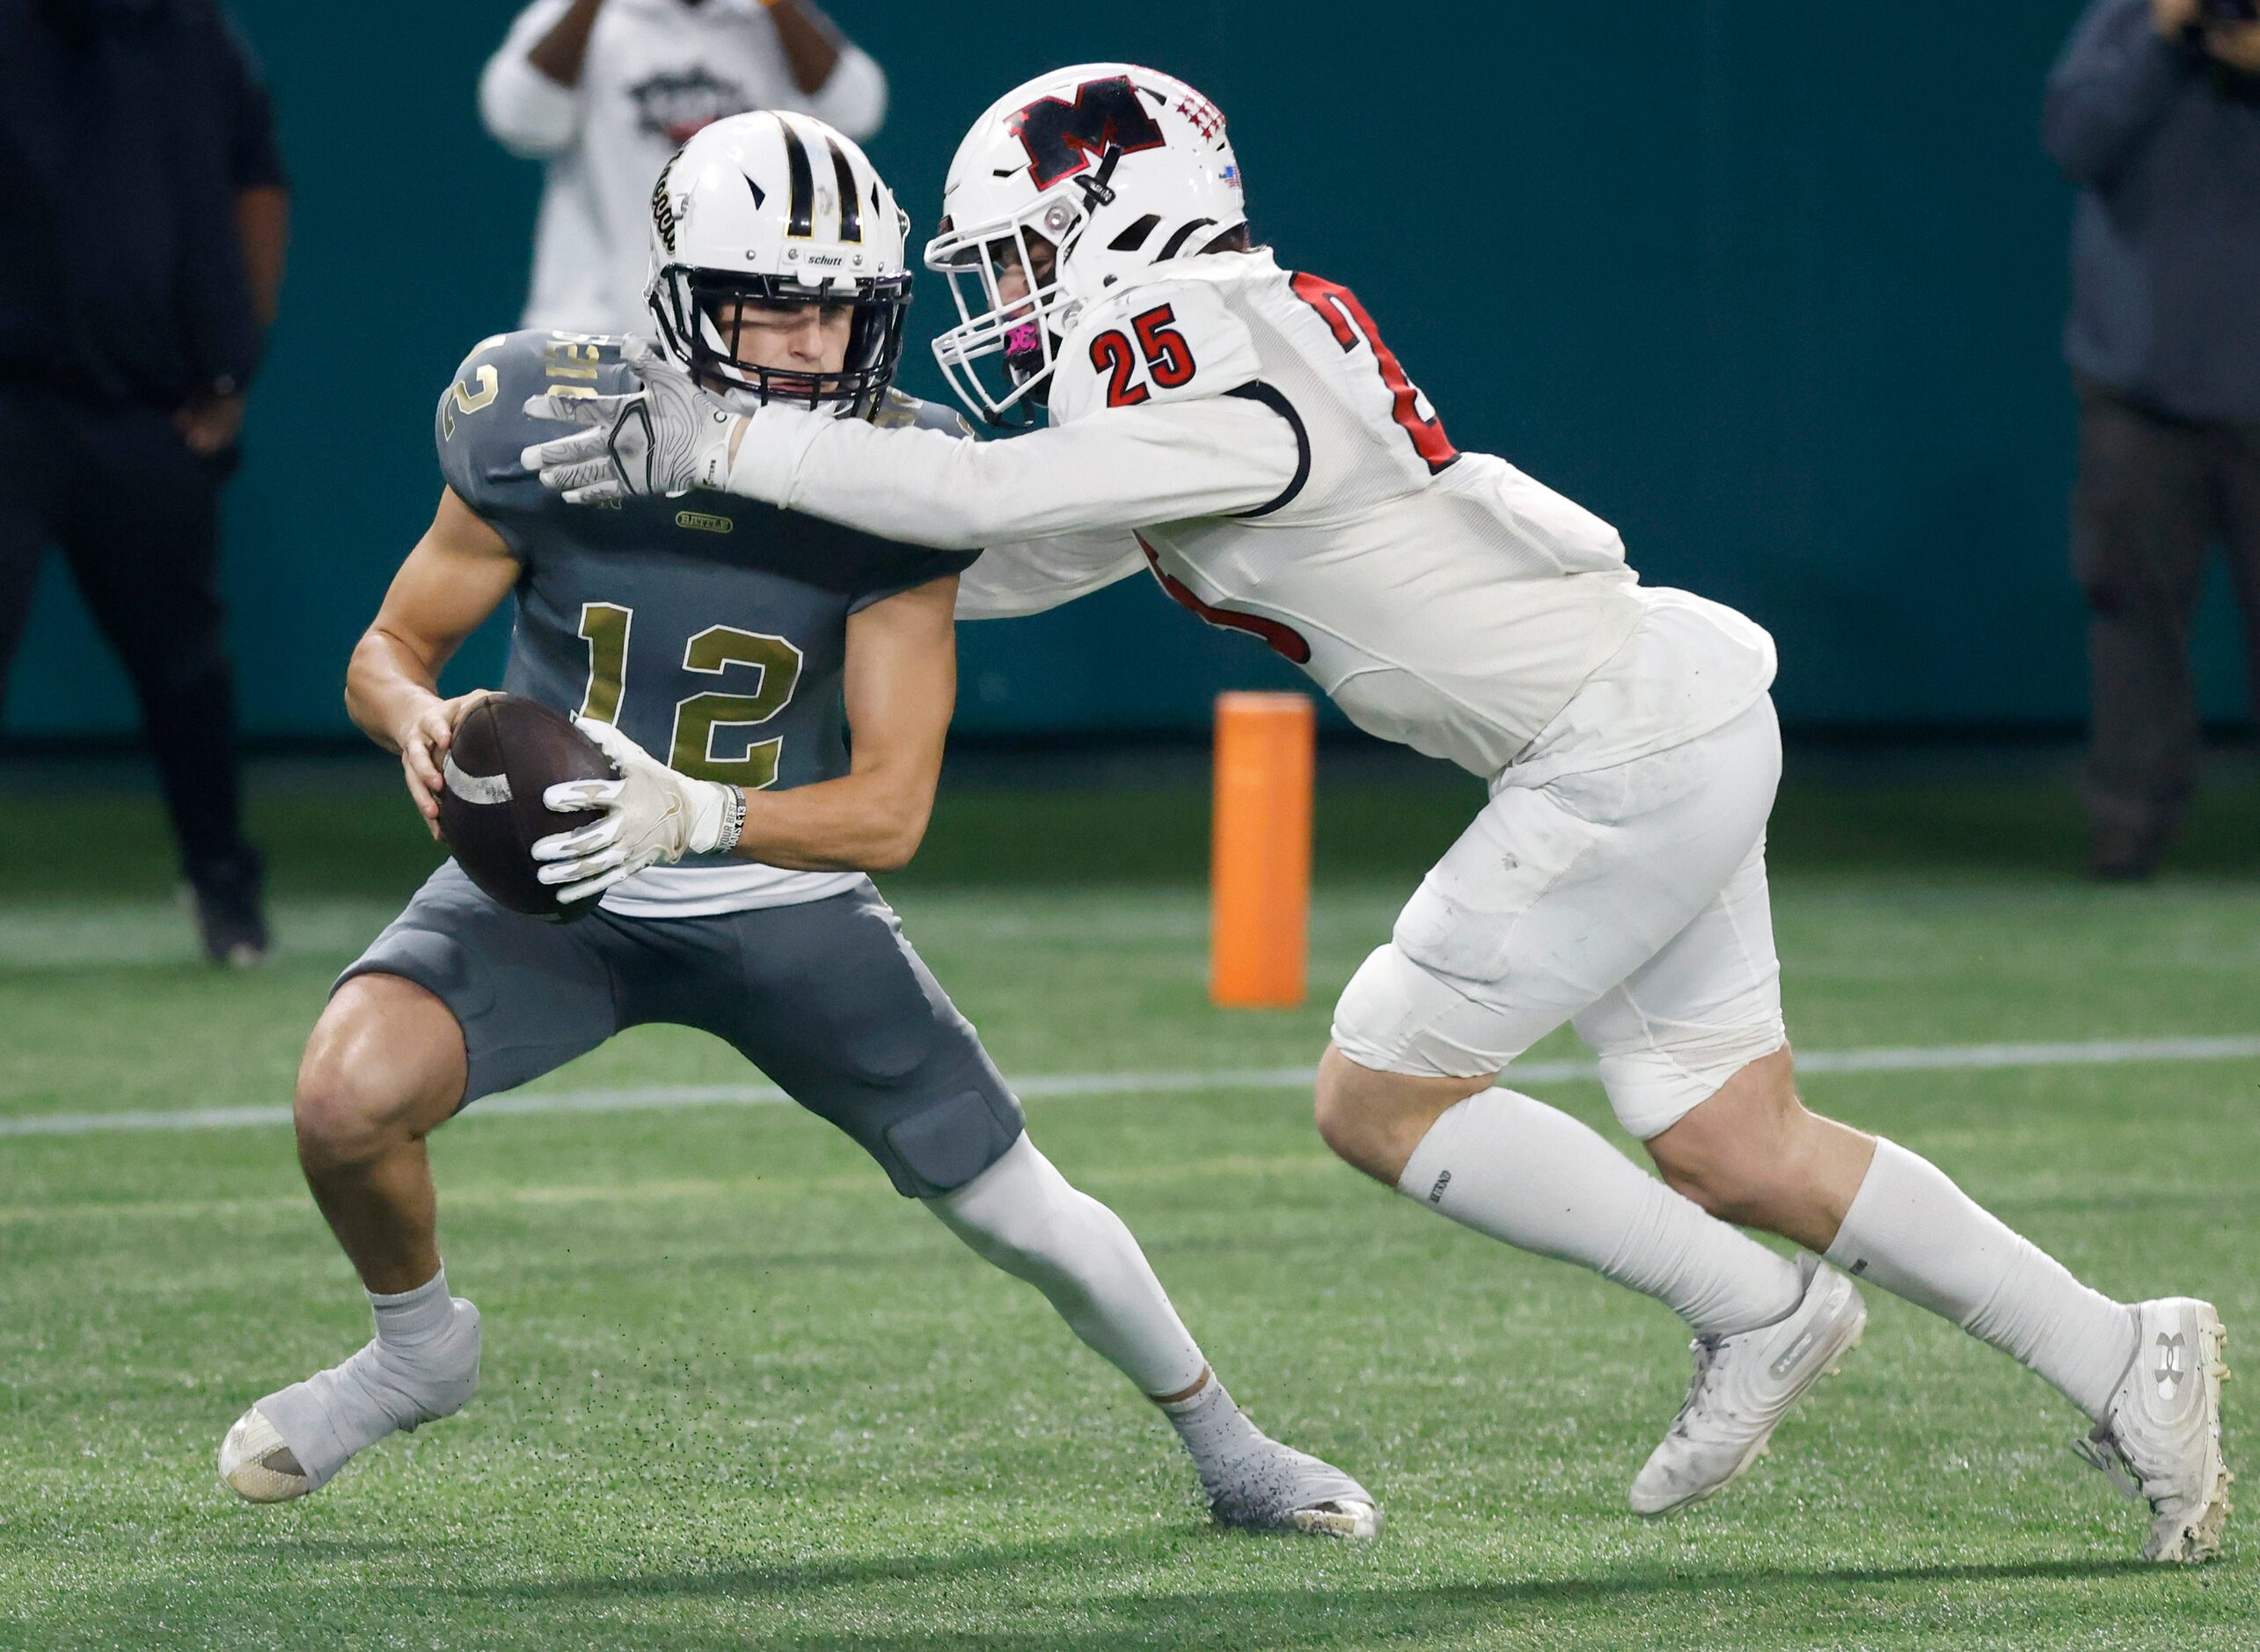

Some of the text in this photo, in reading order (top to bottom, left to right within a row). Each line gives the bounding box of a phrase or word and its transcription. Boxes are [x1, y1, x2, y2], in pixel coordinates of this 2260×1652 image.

[1003, 75, 1167, 191] M
[808, 253, 842, 266] schutt
[1088, 302, 1196, 408] 25
[570, 603, 803, 790] 12
